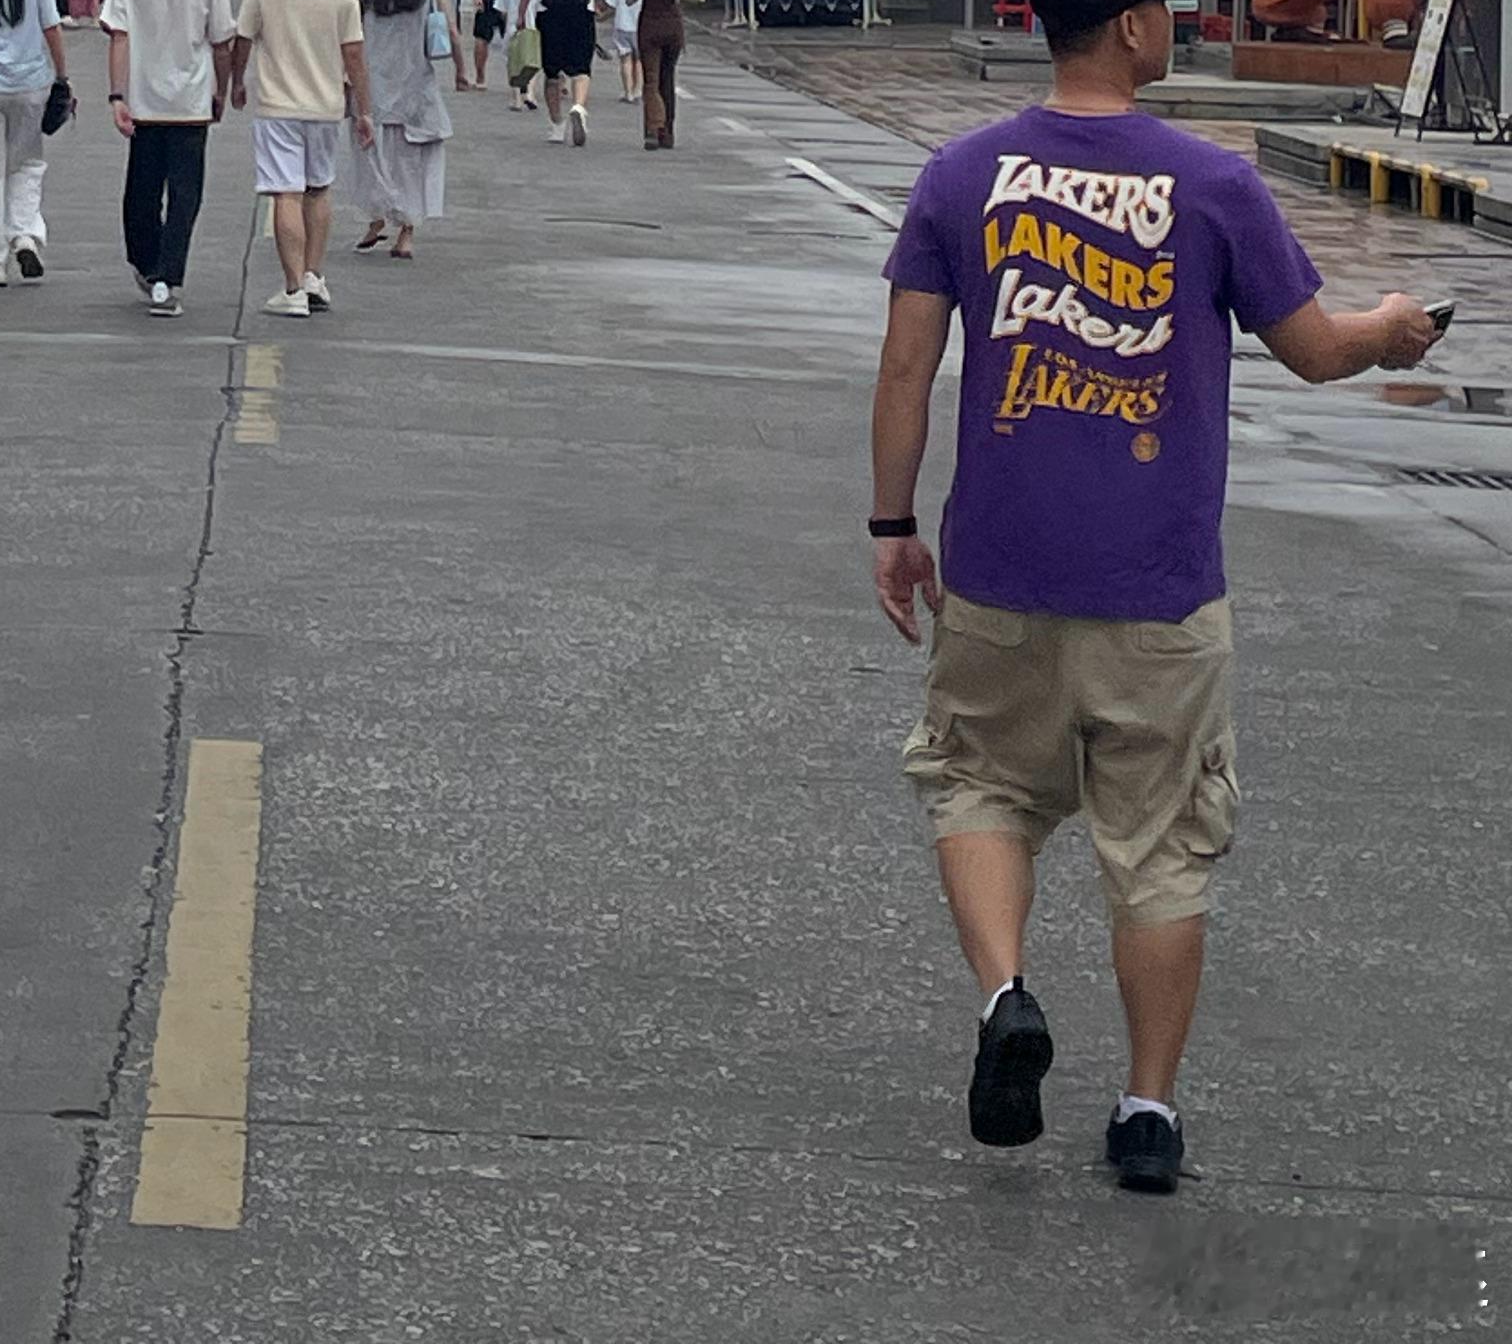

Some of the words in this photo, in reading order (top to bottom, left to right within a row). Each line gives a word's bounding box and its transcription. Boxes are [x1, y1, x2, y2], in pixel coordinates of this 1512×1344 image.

[984, 154, 1176, 250] LAKERS
[984, 211, 1176, 311] LAKERS
[990, 268, 1174, 358] Lakers
[994, 342, 1168, 425] LAKERS
